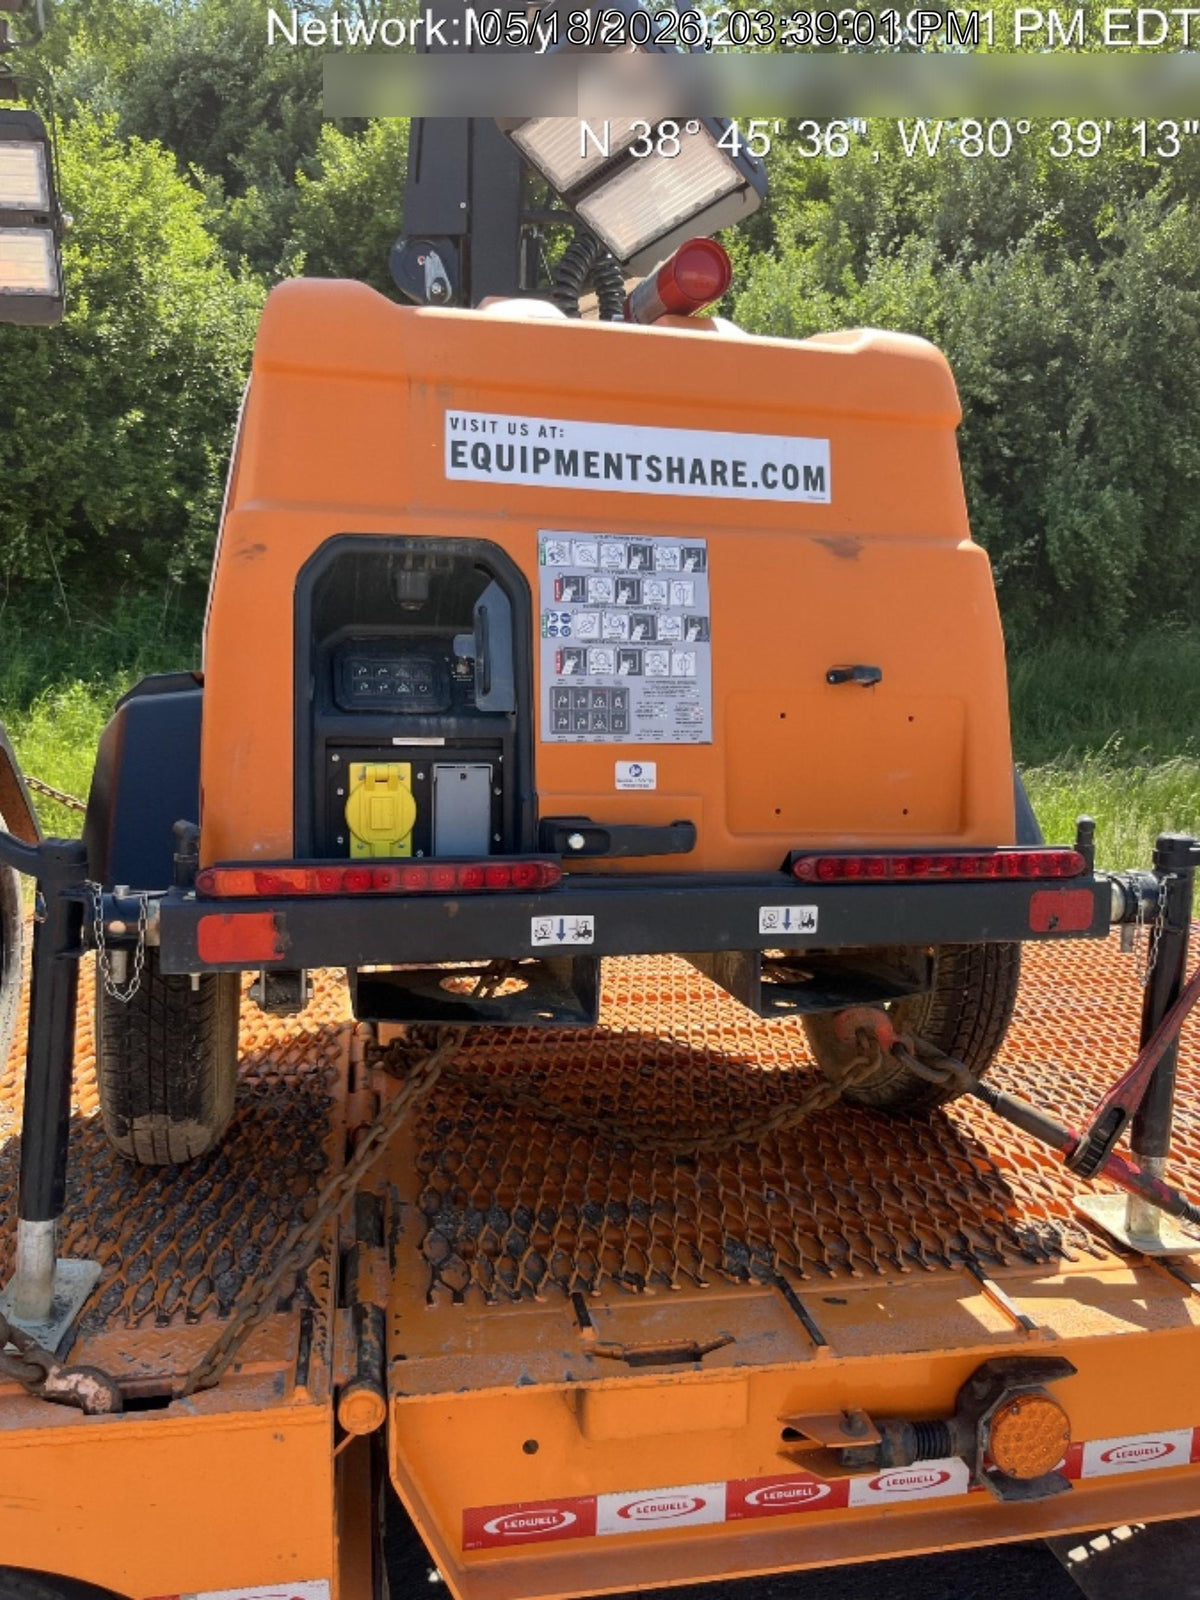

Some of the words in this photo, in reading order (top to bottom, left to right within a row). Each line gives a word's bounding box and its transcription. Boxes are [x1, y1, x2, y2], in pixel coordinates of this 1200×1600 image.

[449, 416, 498, 435] VISIT
[507, 421, 529, 437] US
[538, 424, 565, 439] AT:
[449, 439, 827, 494] EQUIPMENTSHARE.COM
[1115, 1446, 1161, 1459] LEDWELL
[885, 1474, 935, 1487] LEDWELL
[763, 1487, 815, 1500] LEDWELL
[636, 1501, 689, 1515] LEDWELL
[503, 1515, 559, 1530] LEDWELL
